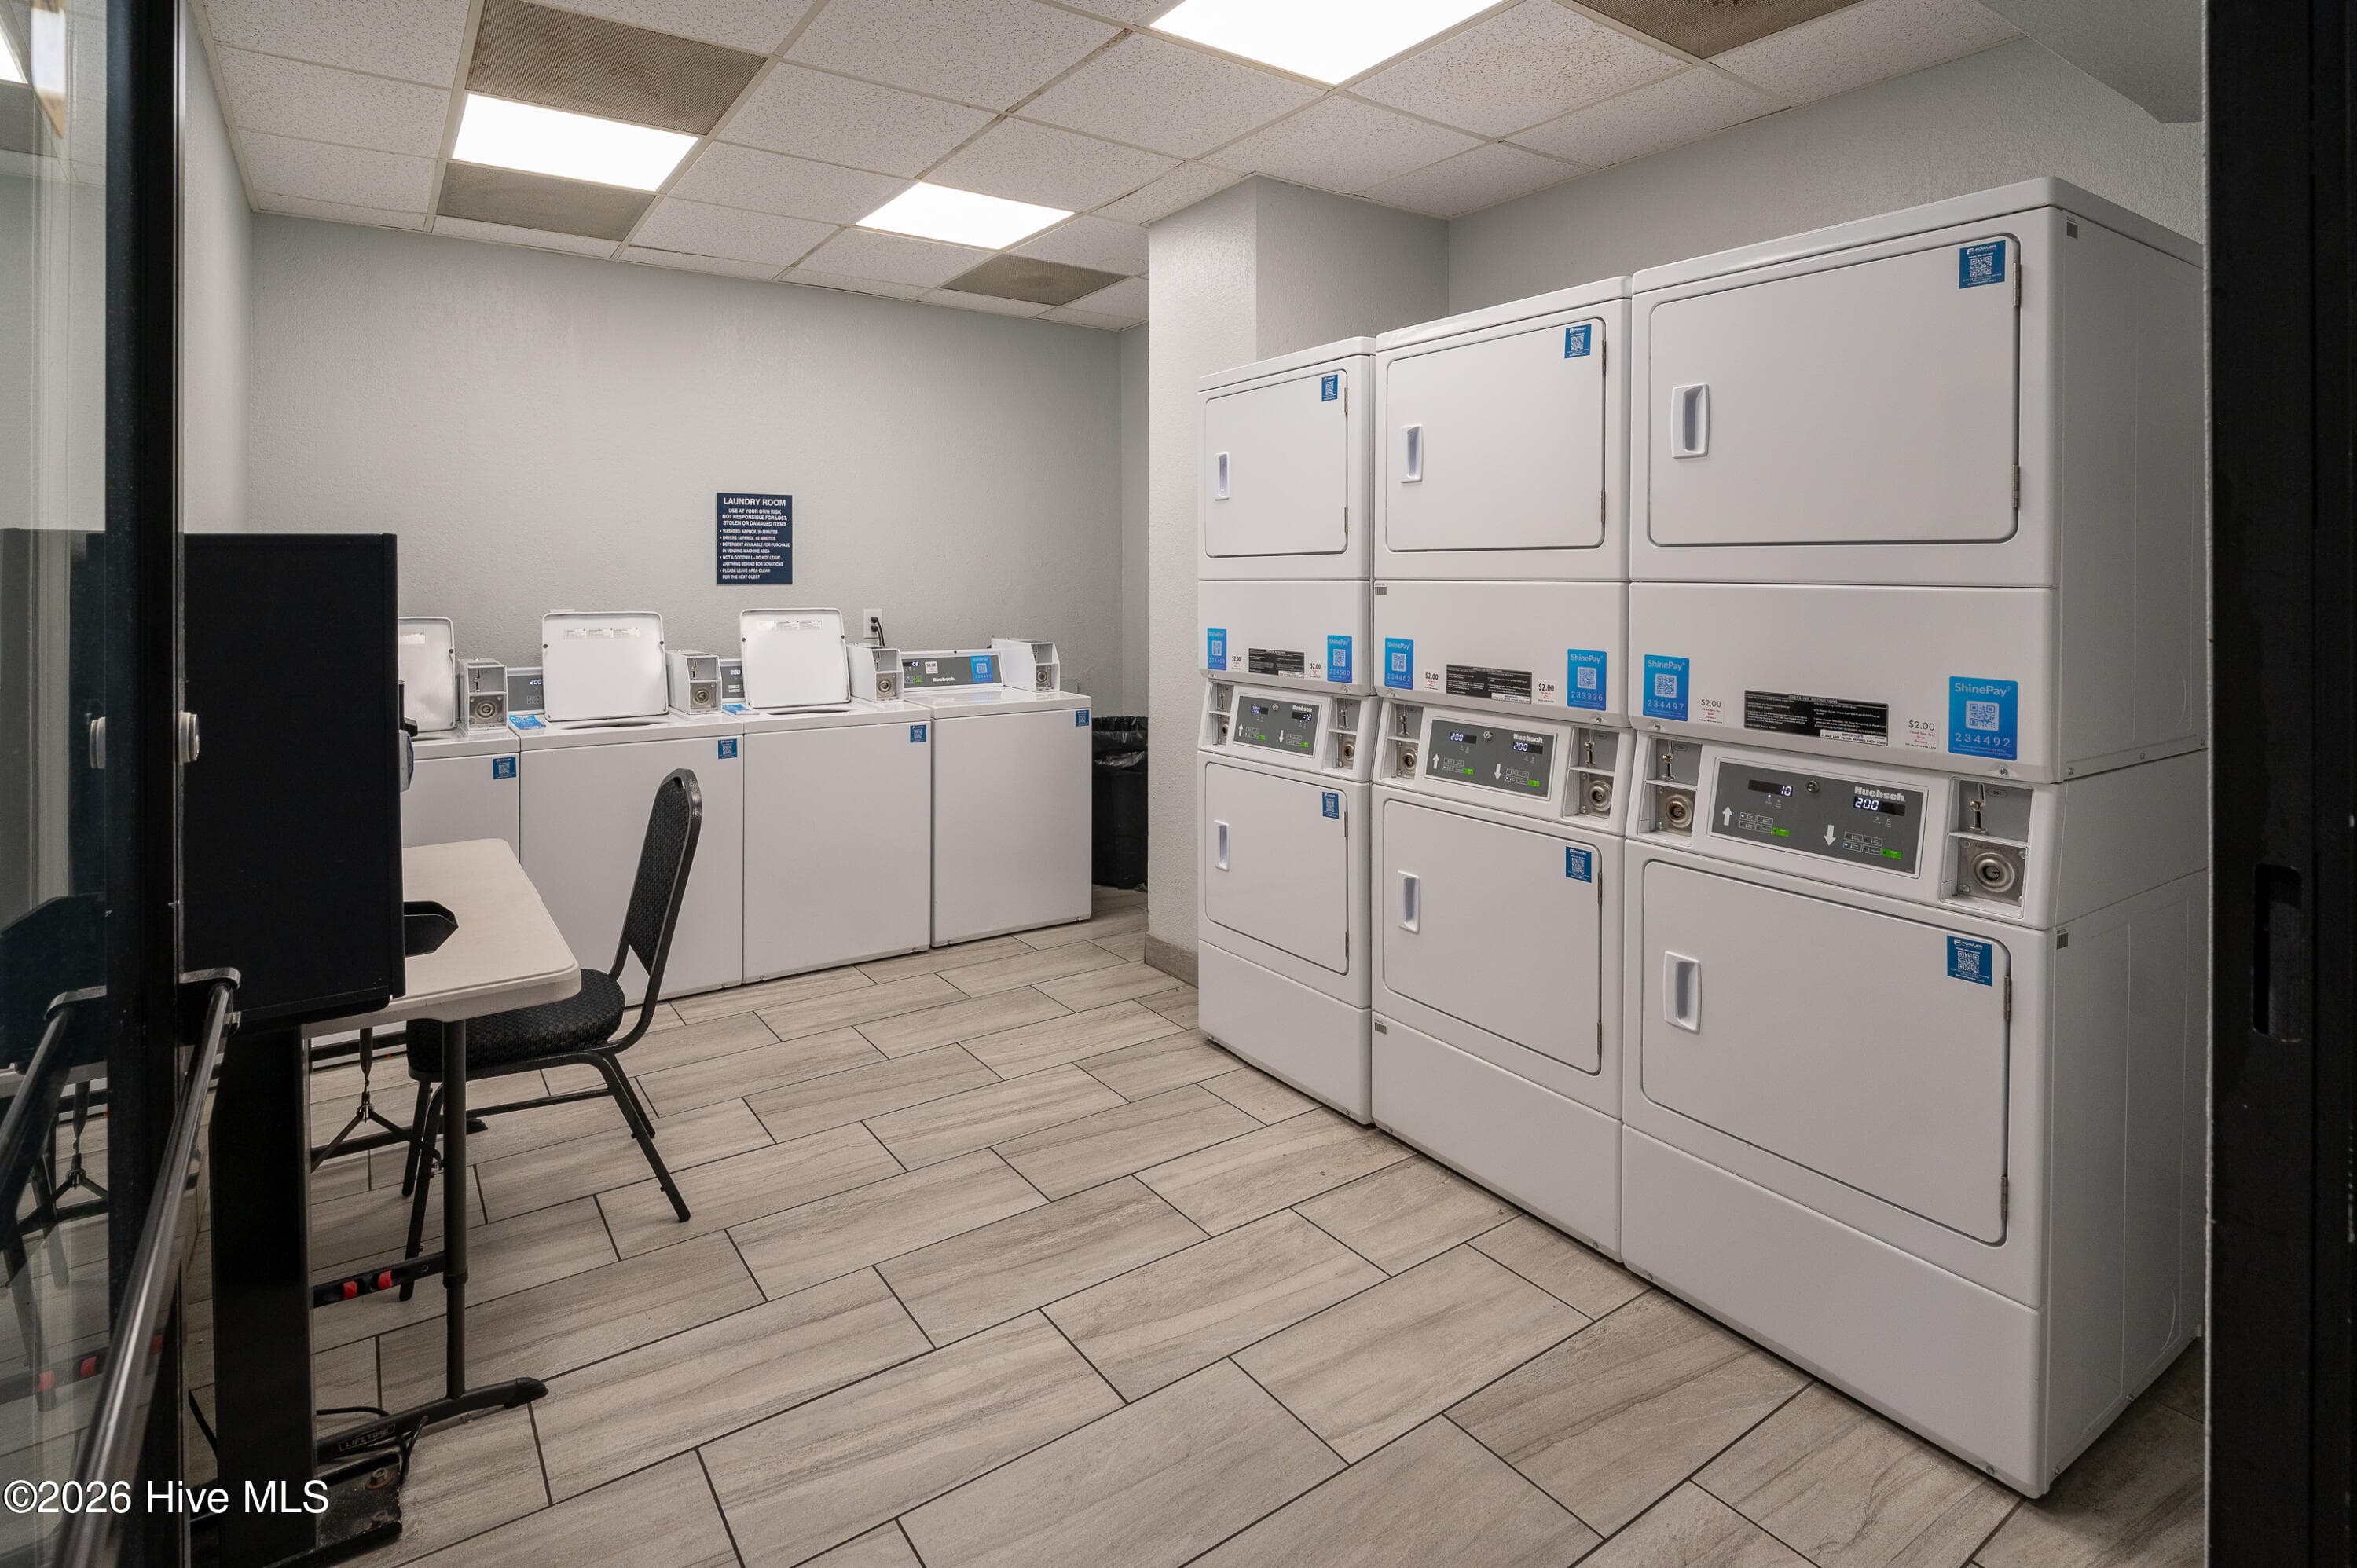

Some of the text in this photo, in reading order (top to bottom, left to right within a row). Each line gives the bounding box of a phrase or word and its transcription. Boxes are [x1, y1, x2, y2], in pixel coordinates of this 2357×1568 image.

[724, 497, 761, 506] LAUNDRY
[1387, 641, 1409, 650] ShinePay
[1571, 653, 1601, 665] ShinePay
[1647, 659, 1682, 672] ShinePay
[1424, 672, 1439, 680] $2.00
[1538, 683, 1555, 692] $2.00
[1954, 682, 2007, 698] ShinePay
[1571, 691, 1604, 702] 233336
[1647, 699, 1684, 711] 234497
[1700, 698, 1722, 708] $2.00
[1908, 720, 1936, 731] $2.00
[1513, 733, 1544, 743] Huebsch
[1954, 732, 2011, 747] 234492
[1780, 786, 1792, 797] 10
[1854, 786, 1905, 802] Huebsch
[1854, 797, 1879, 811] 200
